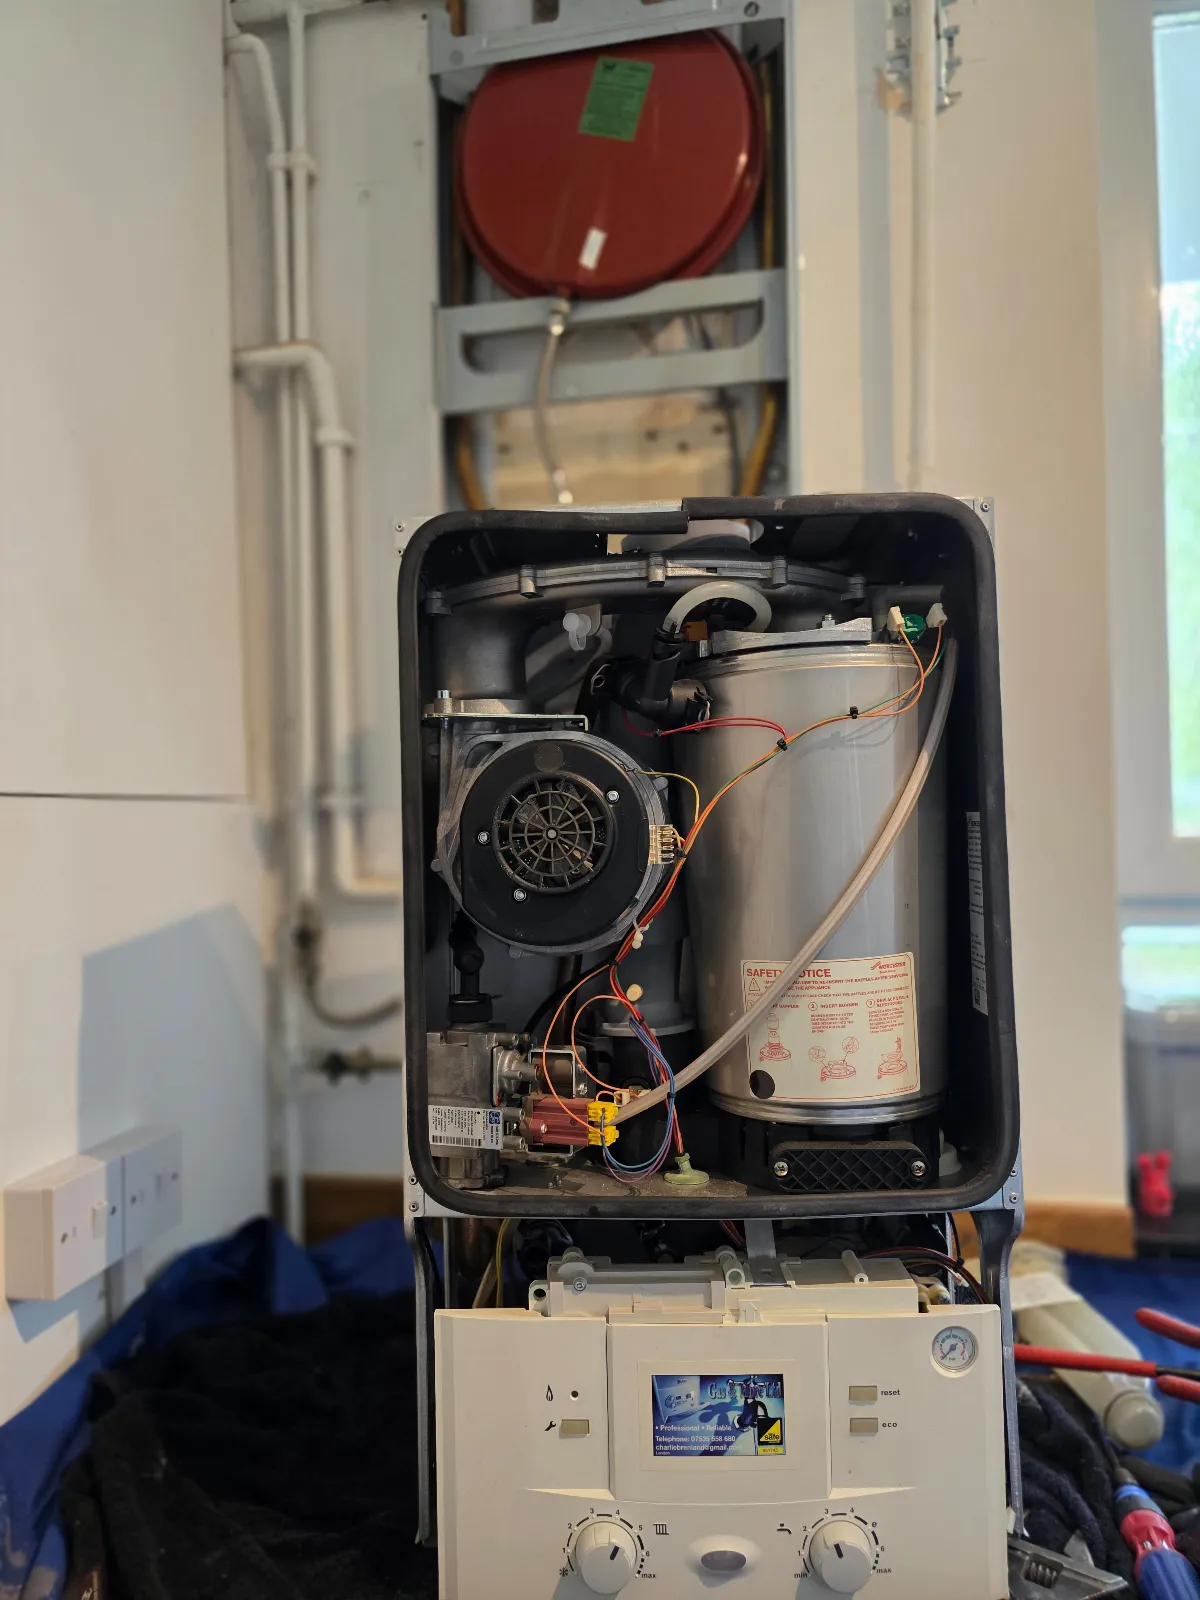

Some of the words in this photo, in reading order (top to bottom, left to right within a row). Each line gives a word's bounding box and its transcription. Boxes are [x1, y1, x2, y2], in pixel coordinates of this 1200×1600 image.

[799, 968, 831, 978] OTICE
[660, 1424, 700, 1432] Professional
[706, 1424, 732, 1432] Reliable
[655, 1435, 690, 1443] Telephone:
[589, 1507, 595, 1515] 3
